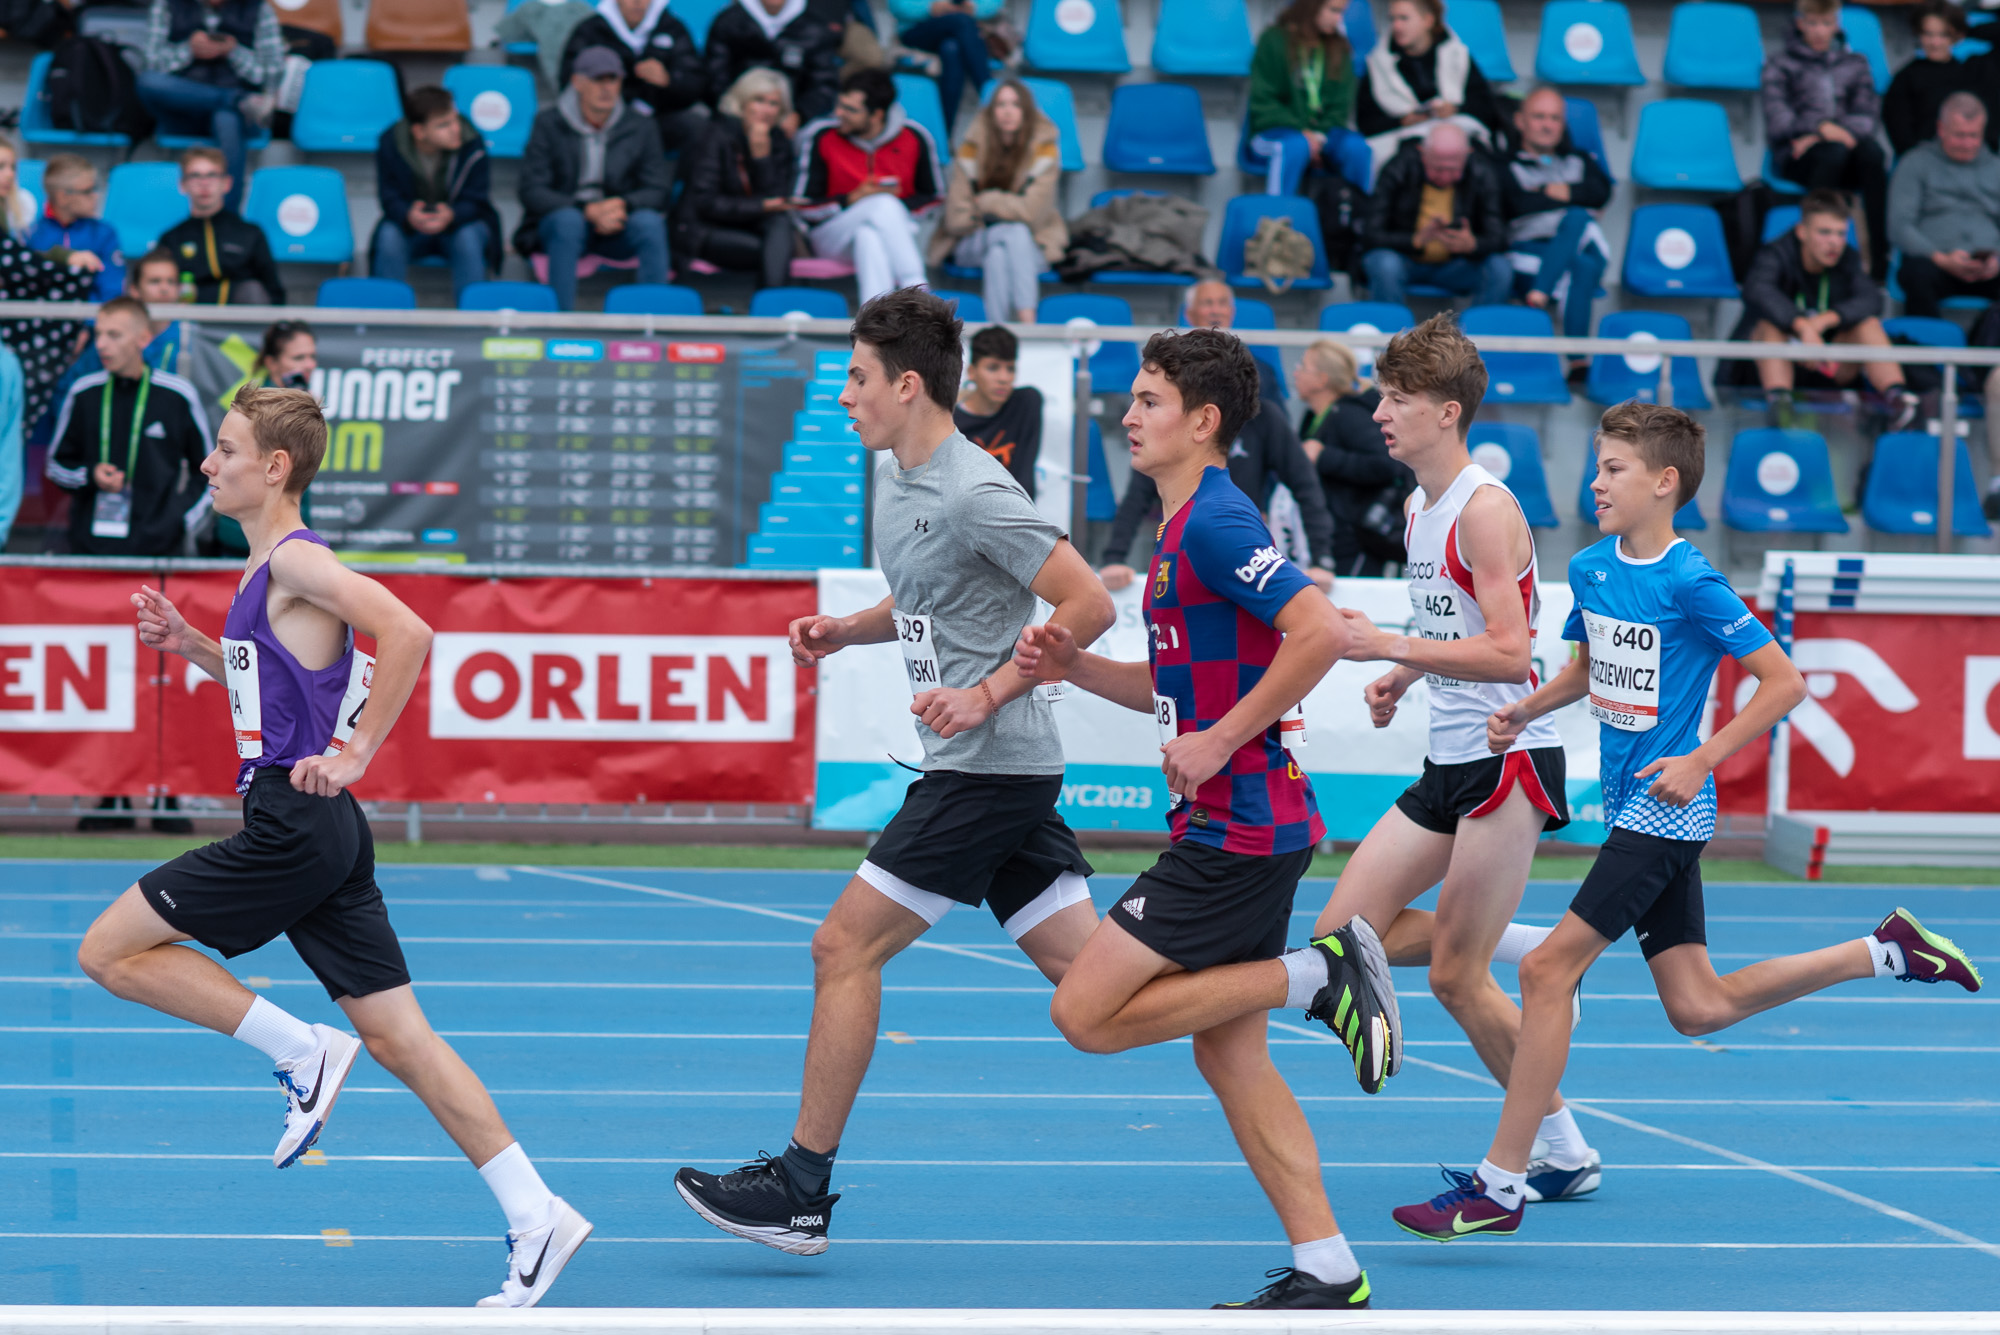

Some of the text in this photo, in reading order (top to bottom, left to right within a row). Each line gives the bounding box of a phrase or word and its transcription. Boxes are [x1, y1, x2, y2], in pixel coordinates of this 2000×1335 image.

[362, 348, 454, 368] PERFECT
[1235, 546, 1283, 583] beko
[1425, 594, 1456, 617] 462
[1612, 624, 1654, 651] 640
[453, 650, 769, 722] ORLEN
[1611, 711, 1636, 727] 2022
[790, 1215, 824, 1227] HOKA
